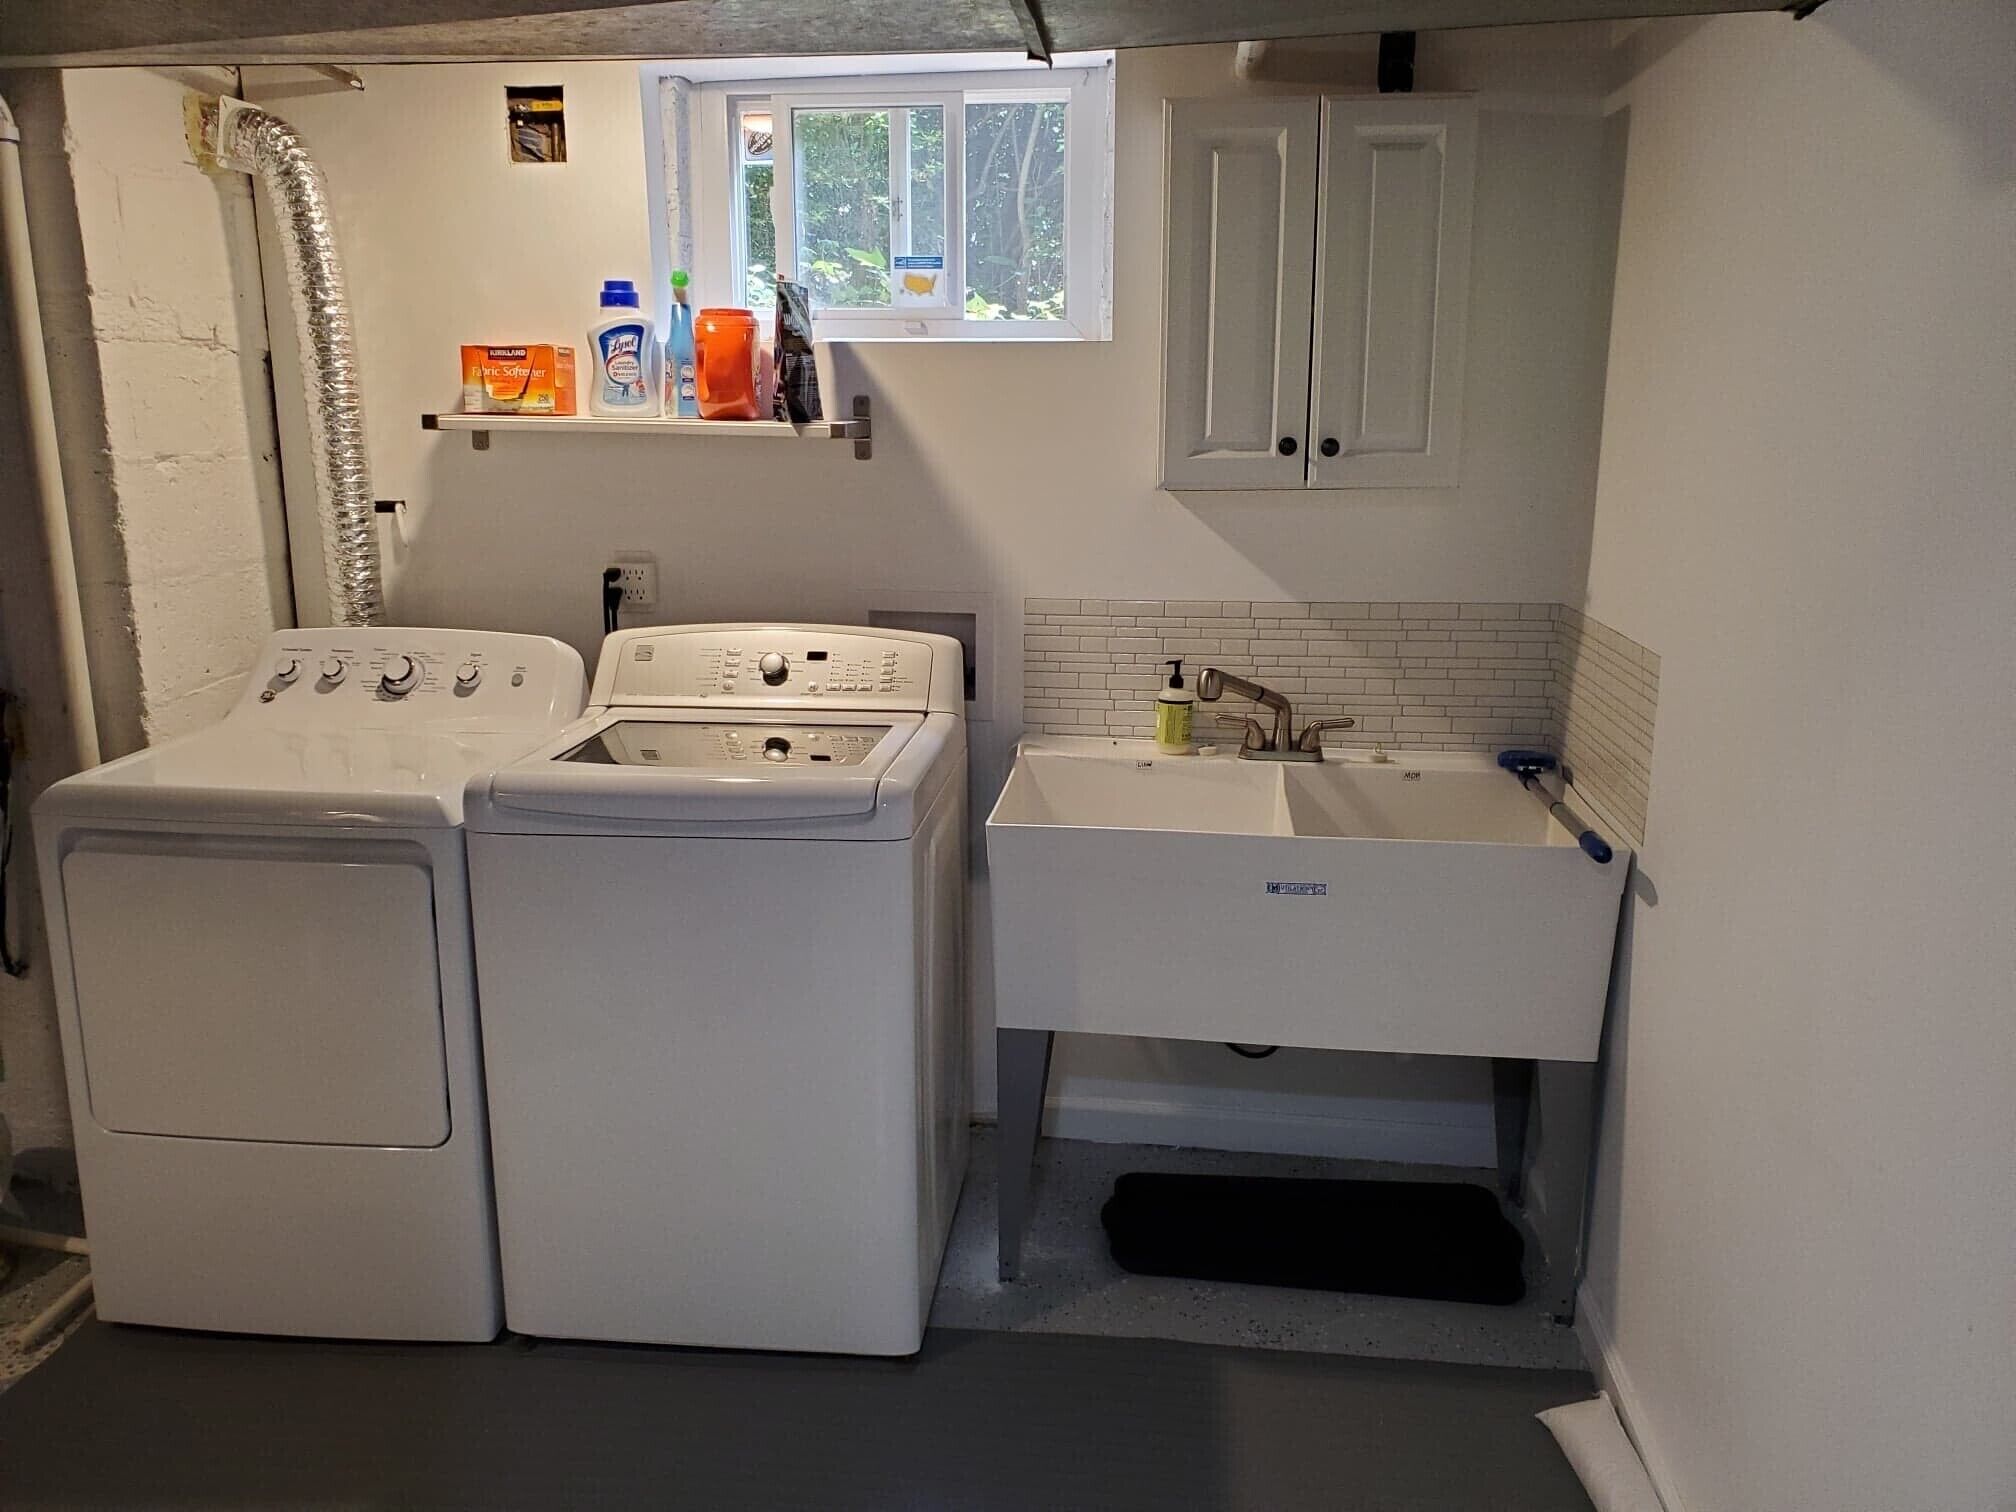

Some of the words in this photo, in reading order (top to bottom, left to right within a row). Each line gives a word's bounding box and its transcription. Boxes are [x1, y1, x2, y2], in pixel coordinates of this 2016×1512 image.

[611, 336, 637, 353] Lysol
[489, 349, 526, 357] KIRKLAND
[472, 366, 499, 377] Fabric
[502, 366, 546, 378] Softener
